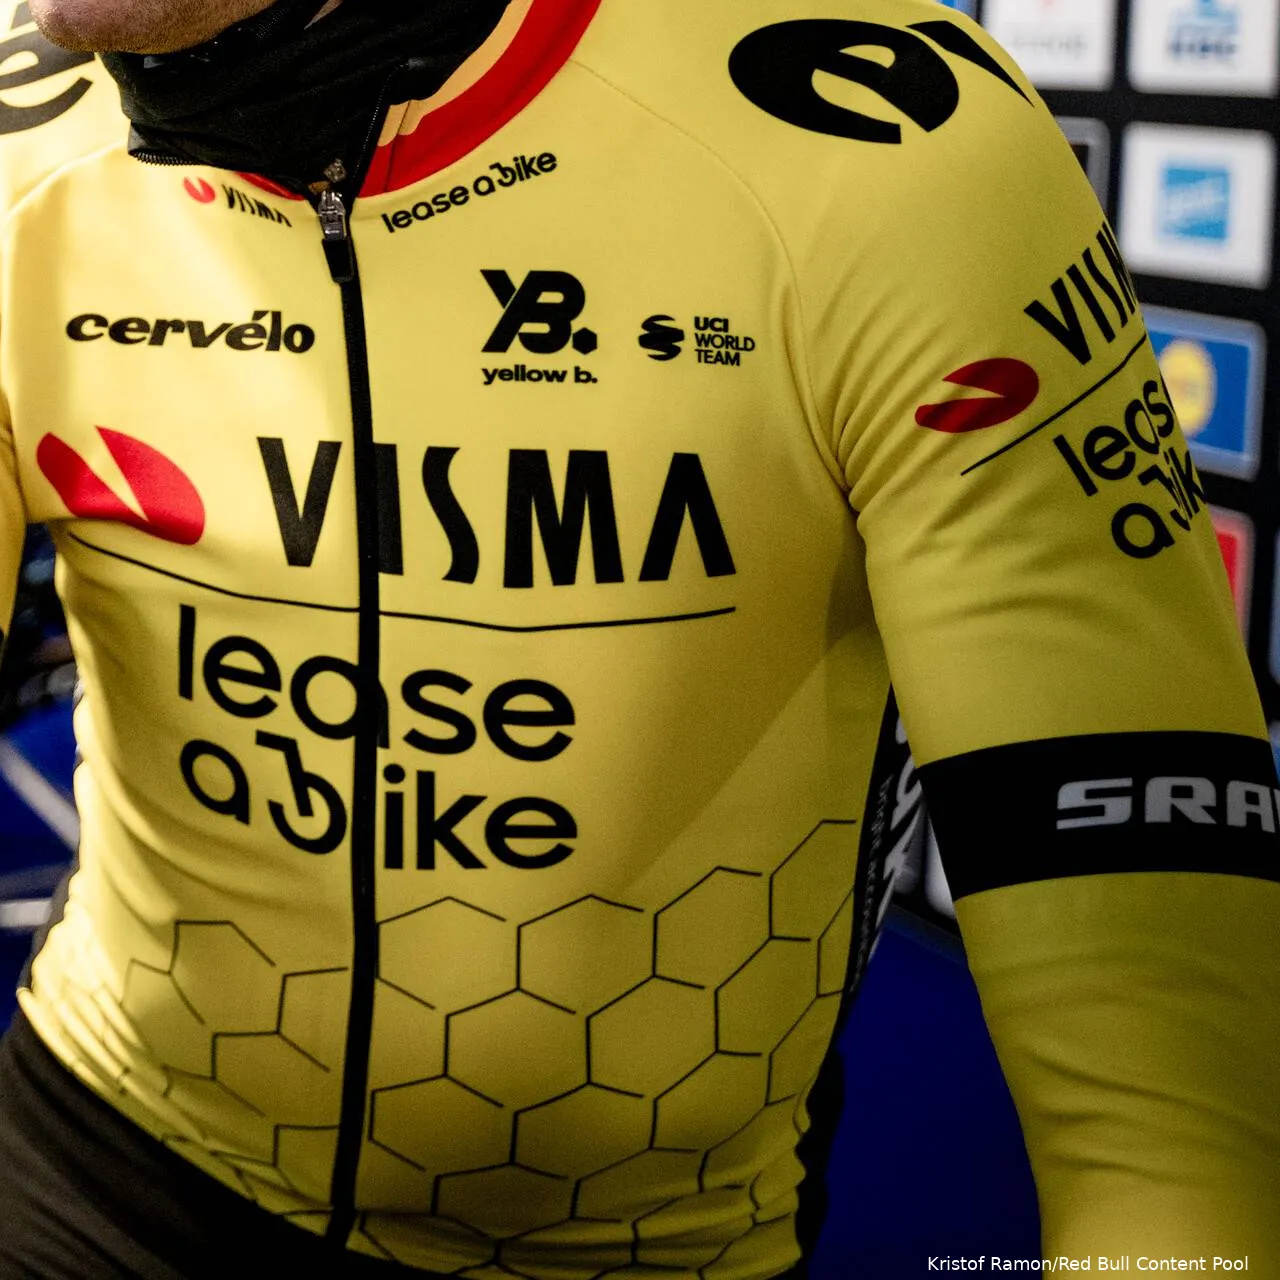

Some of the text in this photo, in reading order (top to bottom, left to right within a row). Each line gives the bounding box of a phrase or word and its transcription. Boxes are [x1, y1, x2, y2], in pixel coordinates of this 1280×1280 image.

[380, 185, 470, 234] lease
[65, 310, 316, 354] cervélo
[693, 316, 730, 333] UCI
[694, 332, 756, 352] WORLD
[481, 364, 599, 386] yellow b.
[695, 349, 741, 367] TEAM
[1052, 373, 1177, 498] leas
[256, 436, 737, 590] VISMA
[177, 604, 577, 763] lease
[1056, 775, 1280, 834] SRA
